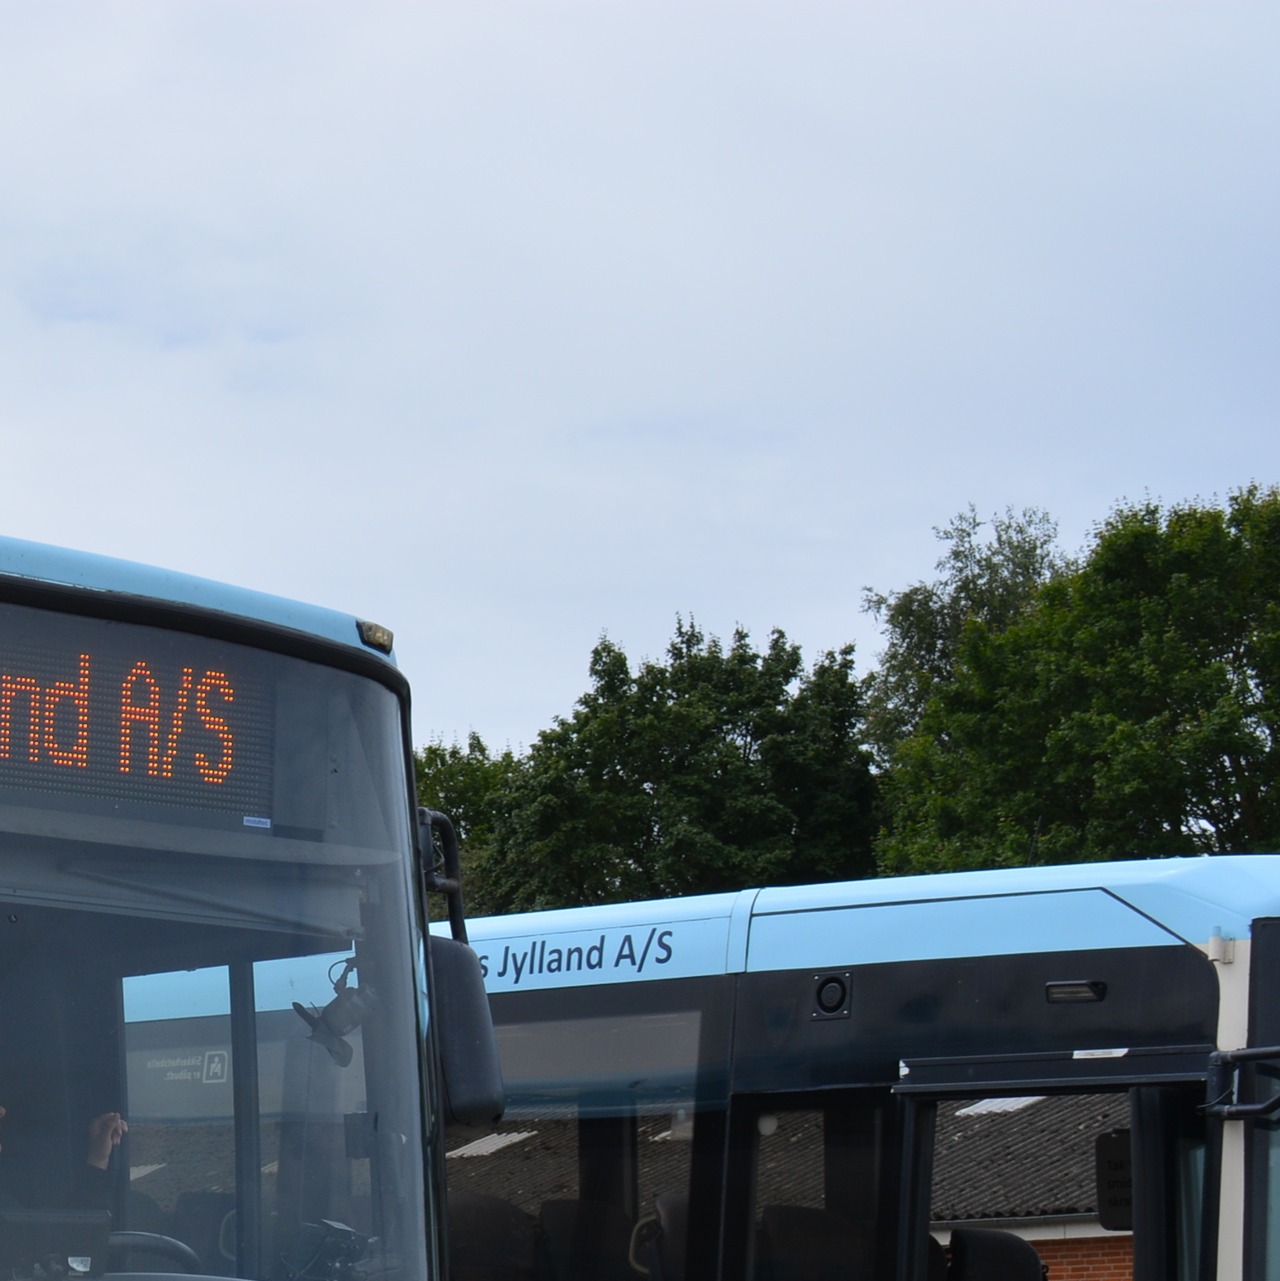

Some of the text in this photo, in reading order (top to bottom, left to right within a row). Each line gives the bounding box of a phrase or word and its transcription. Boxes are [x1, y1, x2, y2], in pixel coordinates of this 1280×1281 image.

[119, 660, 235, 785] A/S
[497, 934, 606, 985] Jylland
[614, 927, 674, 973] A/S
